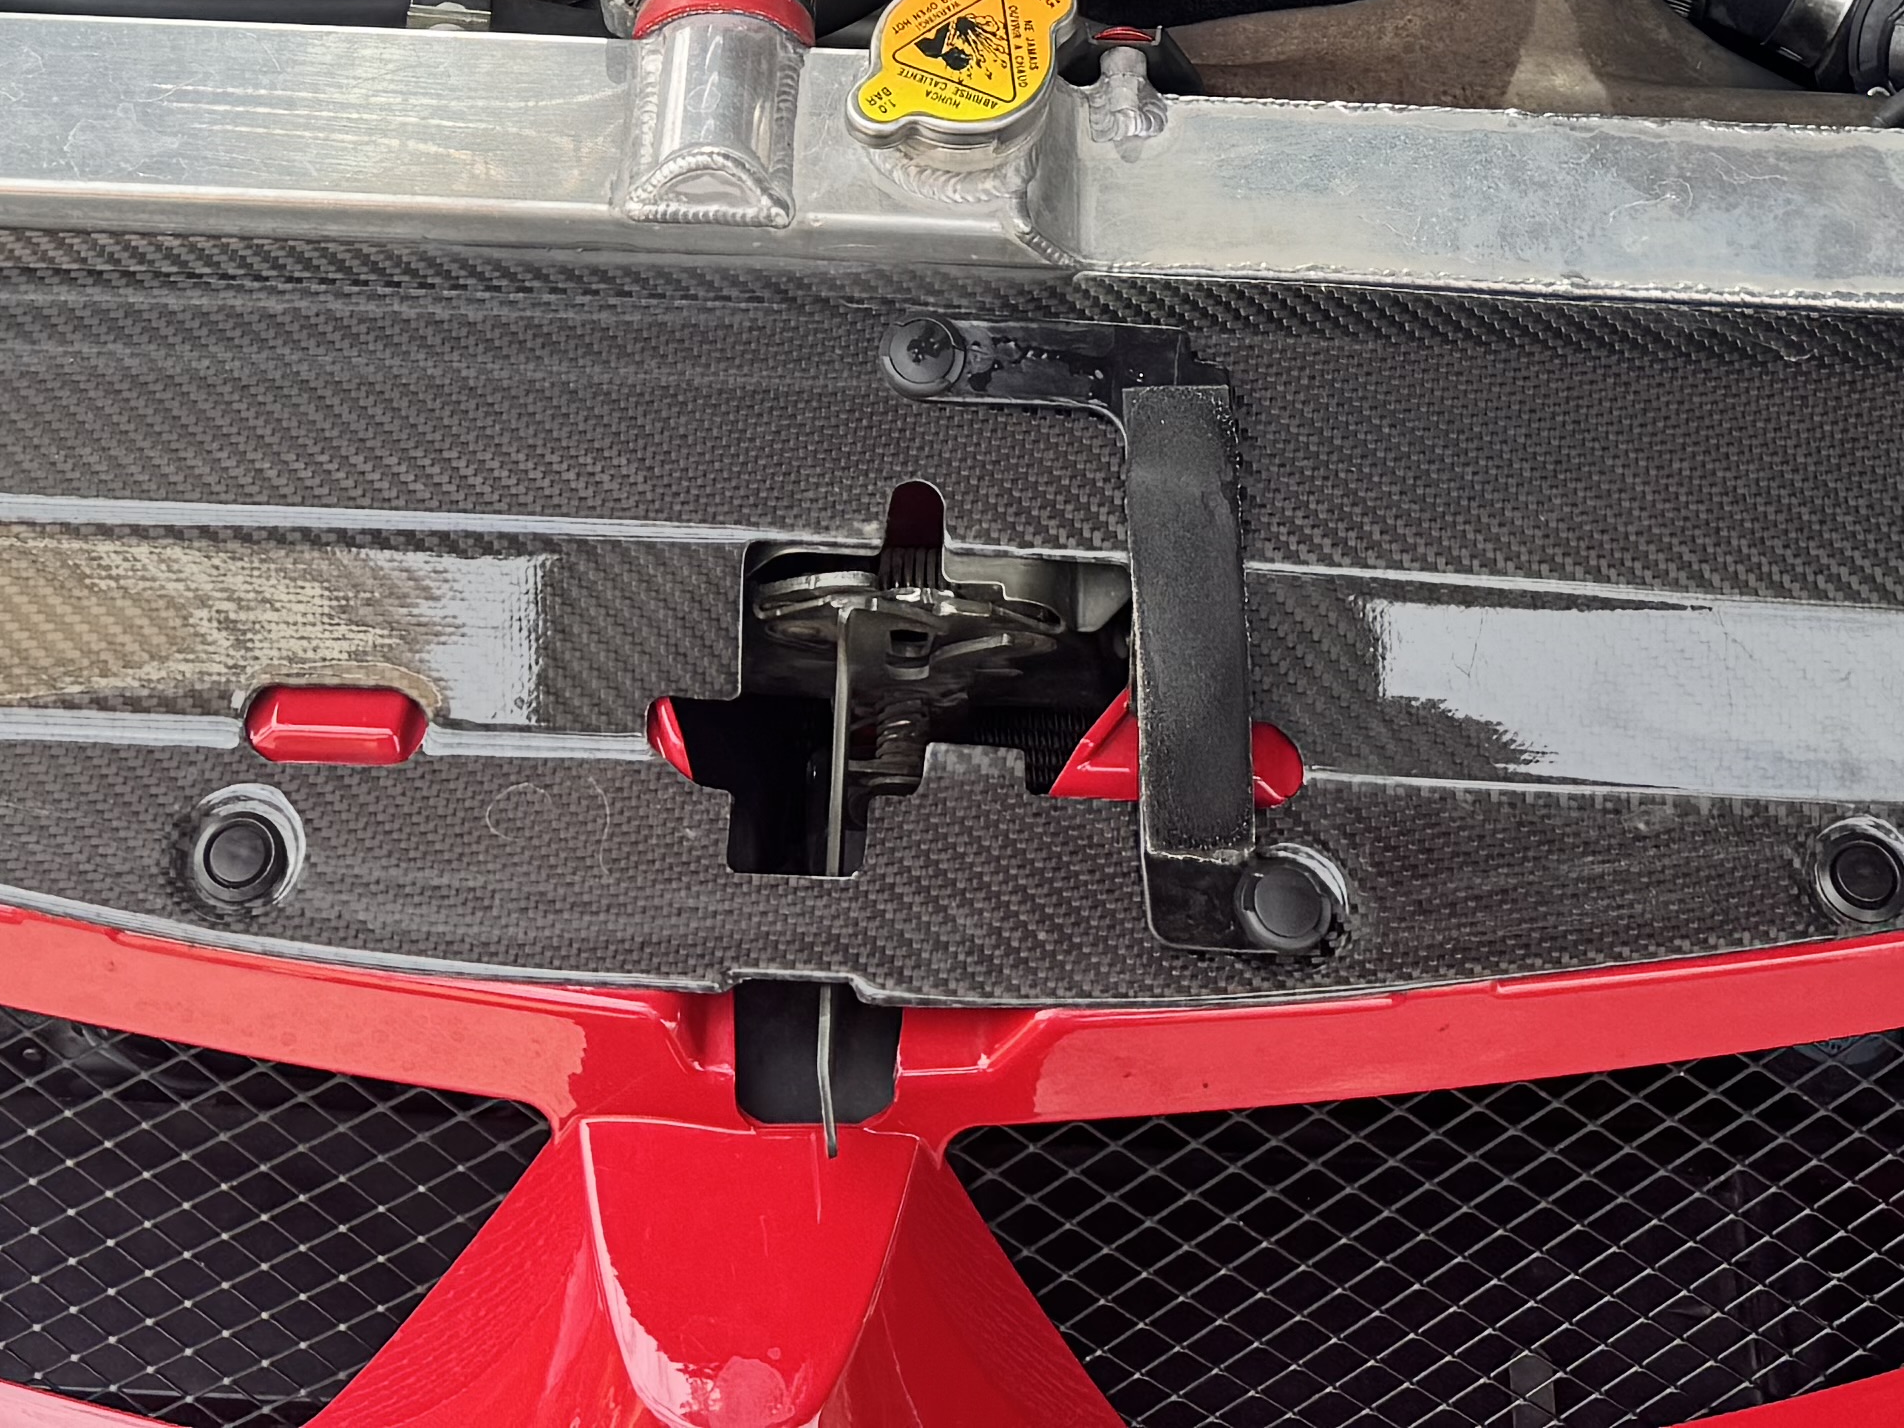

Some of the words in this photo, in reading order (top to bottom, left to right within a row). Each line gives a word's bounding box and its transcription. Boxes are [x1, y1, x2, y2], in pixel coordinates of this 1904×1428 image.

[913, 1, 939, 21] OPEN
[892, 18, 912, 35] HOT
[897, 67, 948, 91] CALIENTE
[866, 86, 892, 106] BAR
[925, 89, 961, 109] NUNCA
[879, 99, 897, 114] 1.0
